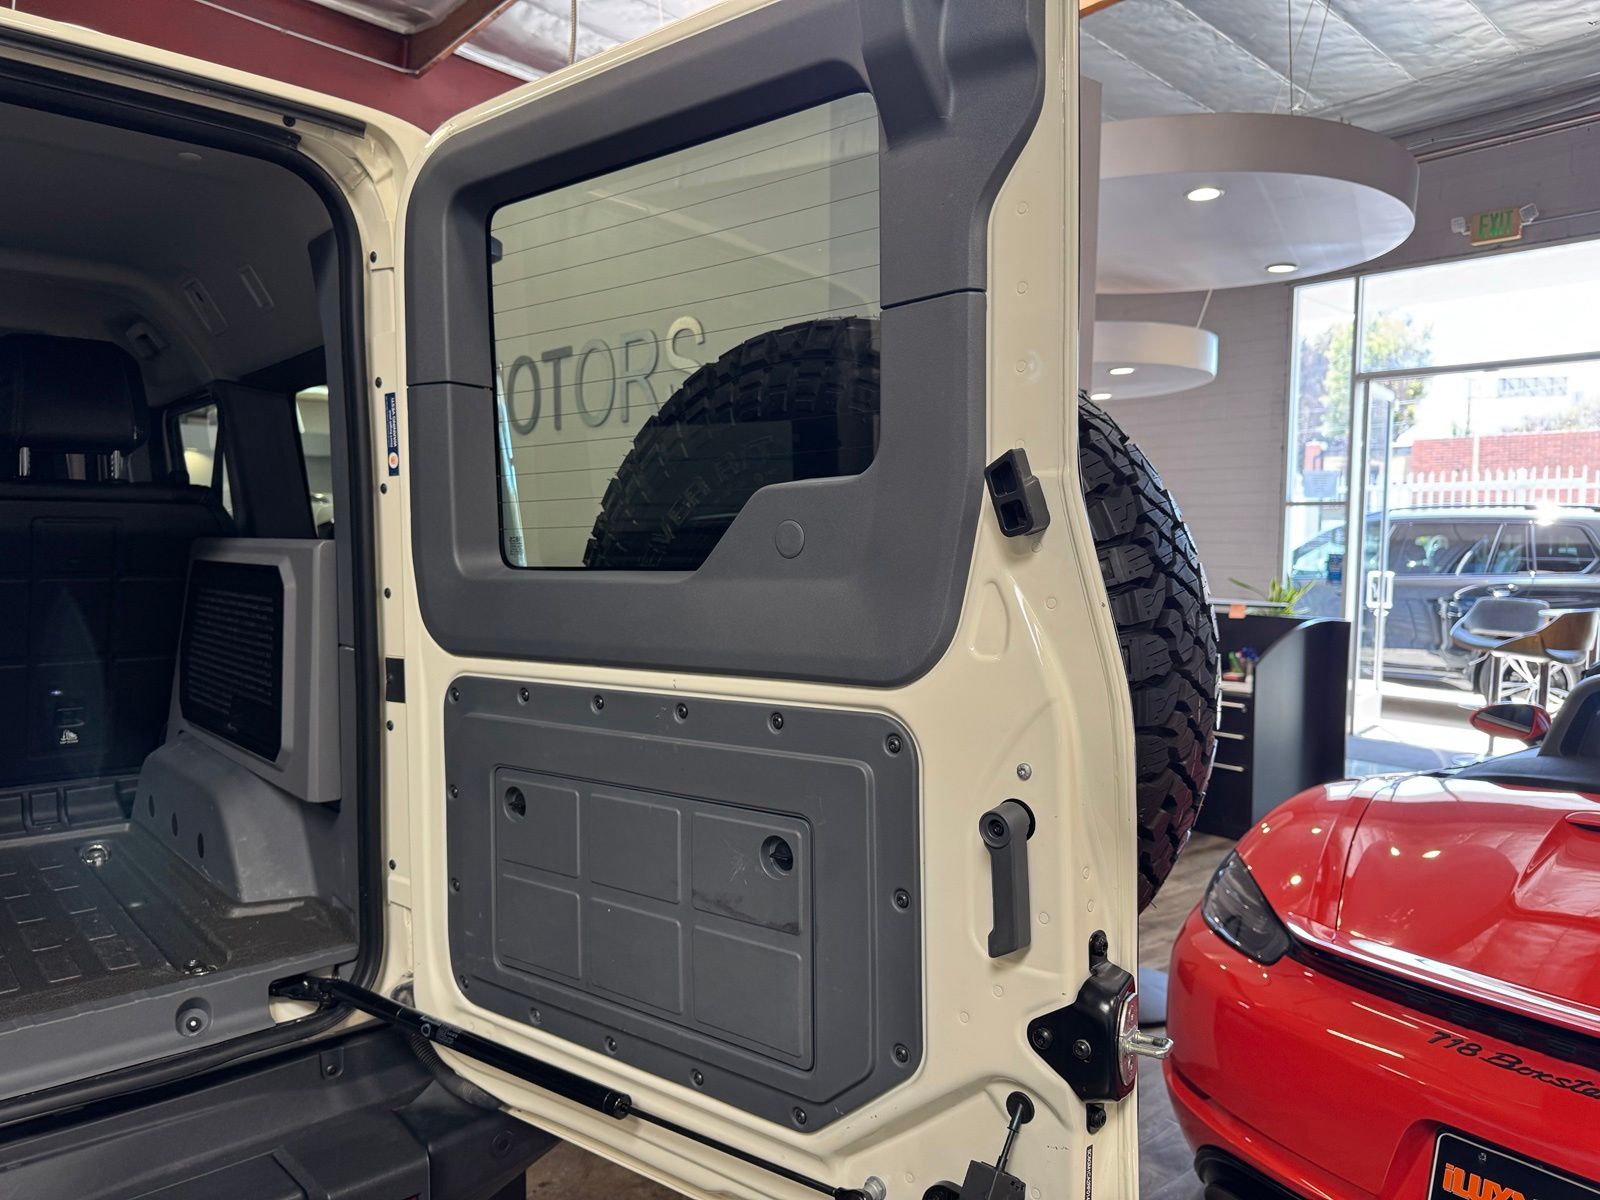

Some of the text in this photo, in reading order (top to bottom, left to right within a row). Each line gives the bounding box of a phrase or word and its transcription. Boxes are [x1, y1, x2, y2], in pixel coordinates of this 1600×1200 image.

[1478, 207, 1514, 238] EXIT
[497, 315, 706, 436] OTORS
[1427, 1031, 1483, 1057] 718
